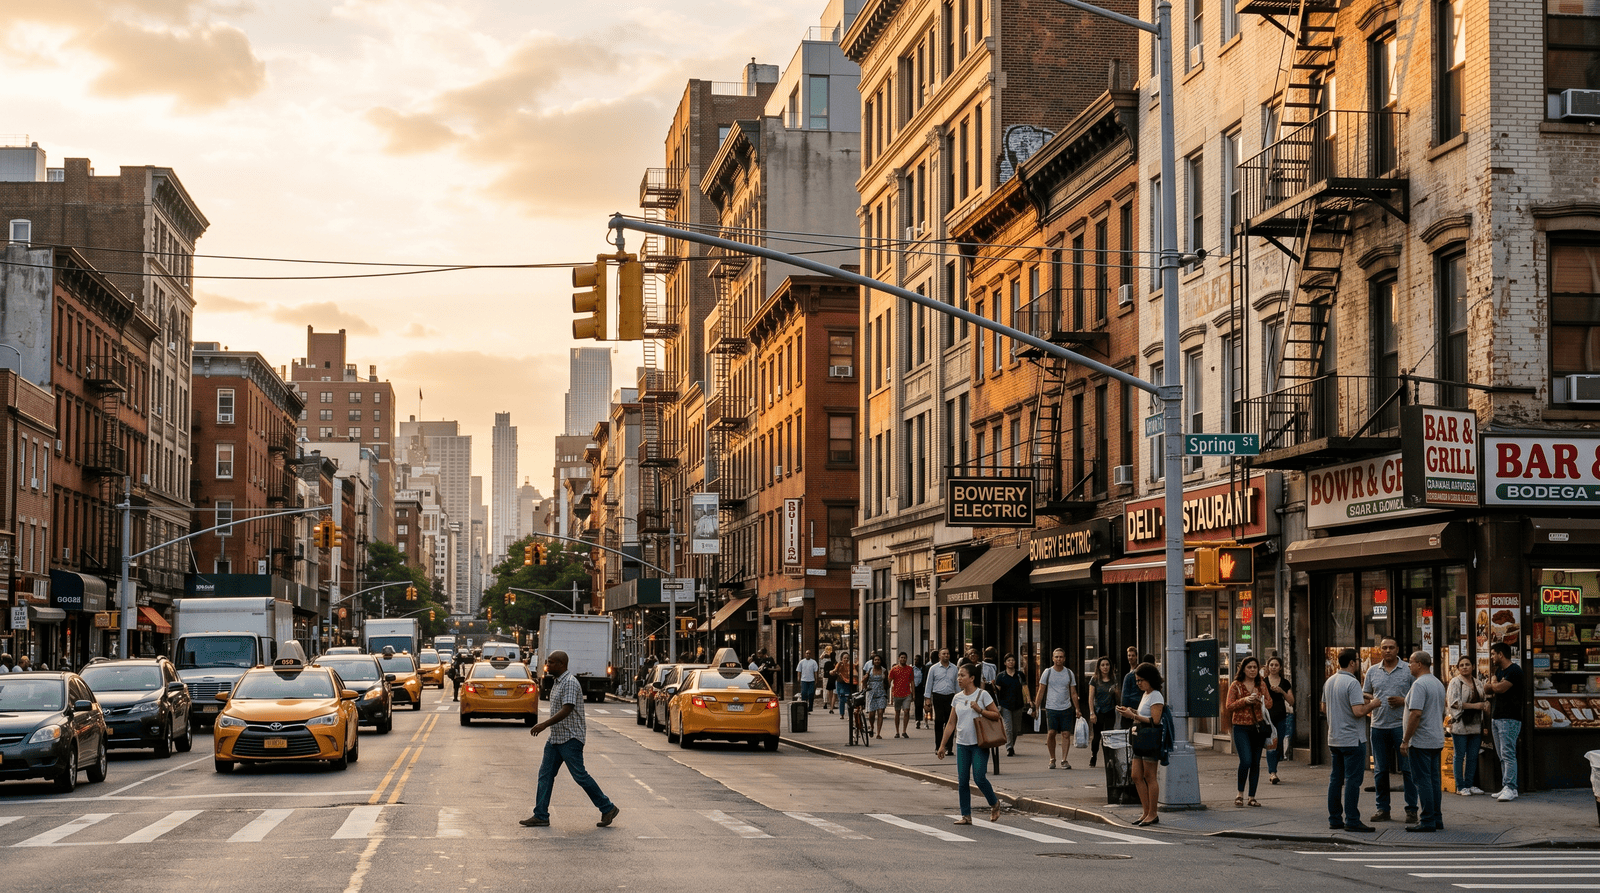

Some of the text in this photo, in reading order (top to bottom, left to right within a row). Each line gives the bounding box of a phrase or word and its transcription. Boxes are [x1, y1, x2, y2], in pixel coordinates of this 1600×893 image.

[1424, 415, 1474, 444] BAR &
[1190, 437, 1253, 455] Spring St
[1426, 446, 1475, 474] GRILL
[1496, 443, 1581, 479] BAR
[954, 486, 1027, 501] BOWERY
[1311, 466, 1364, 506] BOWR
[1367, 463, 1379, 497] &
[1507, 485, 1588, 499] BODEGA
[954, 503, 1027, 518] ELECTRIC
[1128, 487, 1254, 541] DELI STAURANT
[1030, 529, 1091, 561] BOWERY ELECTRIC
[1543, 588, 1579, 604] OPEN
